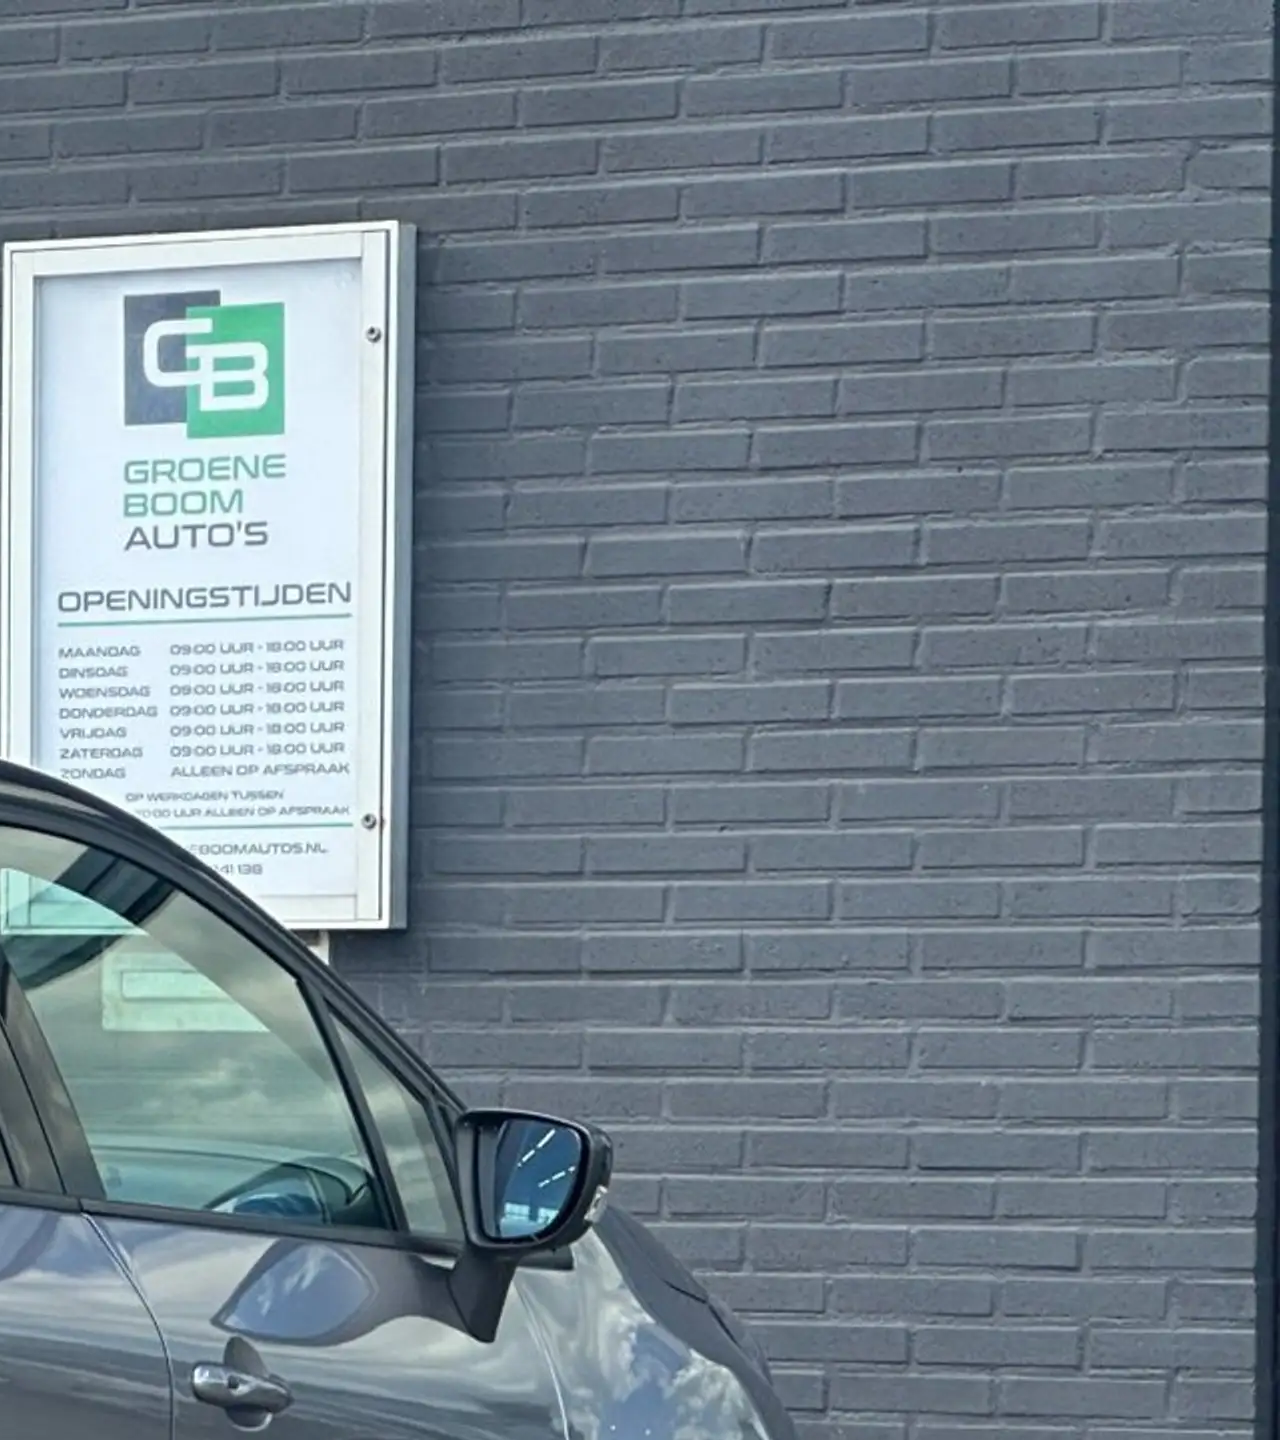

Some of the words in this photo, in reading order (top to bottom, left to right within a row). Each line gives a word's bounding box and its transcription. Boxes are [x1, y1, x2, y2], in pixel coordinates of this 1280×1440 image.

[123, 453, 287, 485] GROENE
[123, 489, 244, 518] BOOM
[123, 521, 269, 551] AUTO'S
[57, 581, 352, 613] OPENINGSTIJDEN
[58, 646, 141, 659] MAANDAG
[220, 642, 254, 654] UUR
[309, 639, 345, 651] UUR
[58, 666, 129, 680] DINSDAG
[220, 662, 254, 674] UUR
[309, 659, 345, 671] UUR
[58, 686, 151, 699] WOENSDAG
[220, 683, 254, 695] UUR
[309, 680, 345, 692] UUR
[58, 705, 159, 719] DONDERDAG
[220, 703, 254, 715] UUR
[309, 700, 345, 712] UUR
[59, 726, 128, 739] VRIJDAG
[220, 723, 254, 735] UUR
[309, 720, 345, 732] UUR
[59, 746, 144, 759] ZATERDAG
[220, 744, 254, 756] UUR
[309, 741, 345, 753] UUR
[60, 766, 127, 779] ZONDAG
[170, 765, 233, 778] ALLEEN
[236, 764, 260, 776] OP
[263, 762, 350, 775] AFSPRAAK
[125, 792, 144, 802] OP
[146, 791, 229, 802] WERKDAGEN
[232, 790, 285, 801] TUSSEN
[173, 807, 202, 818] UUR
[205, 806, 255, 818] ALLEEN
[257, 805, 277, 817] OP
[279, 804, 351, 816] AFSPRAAK
